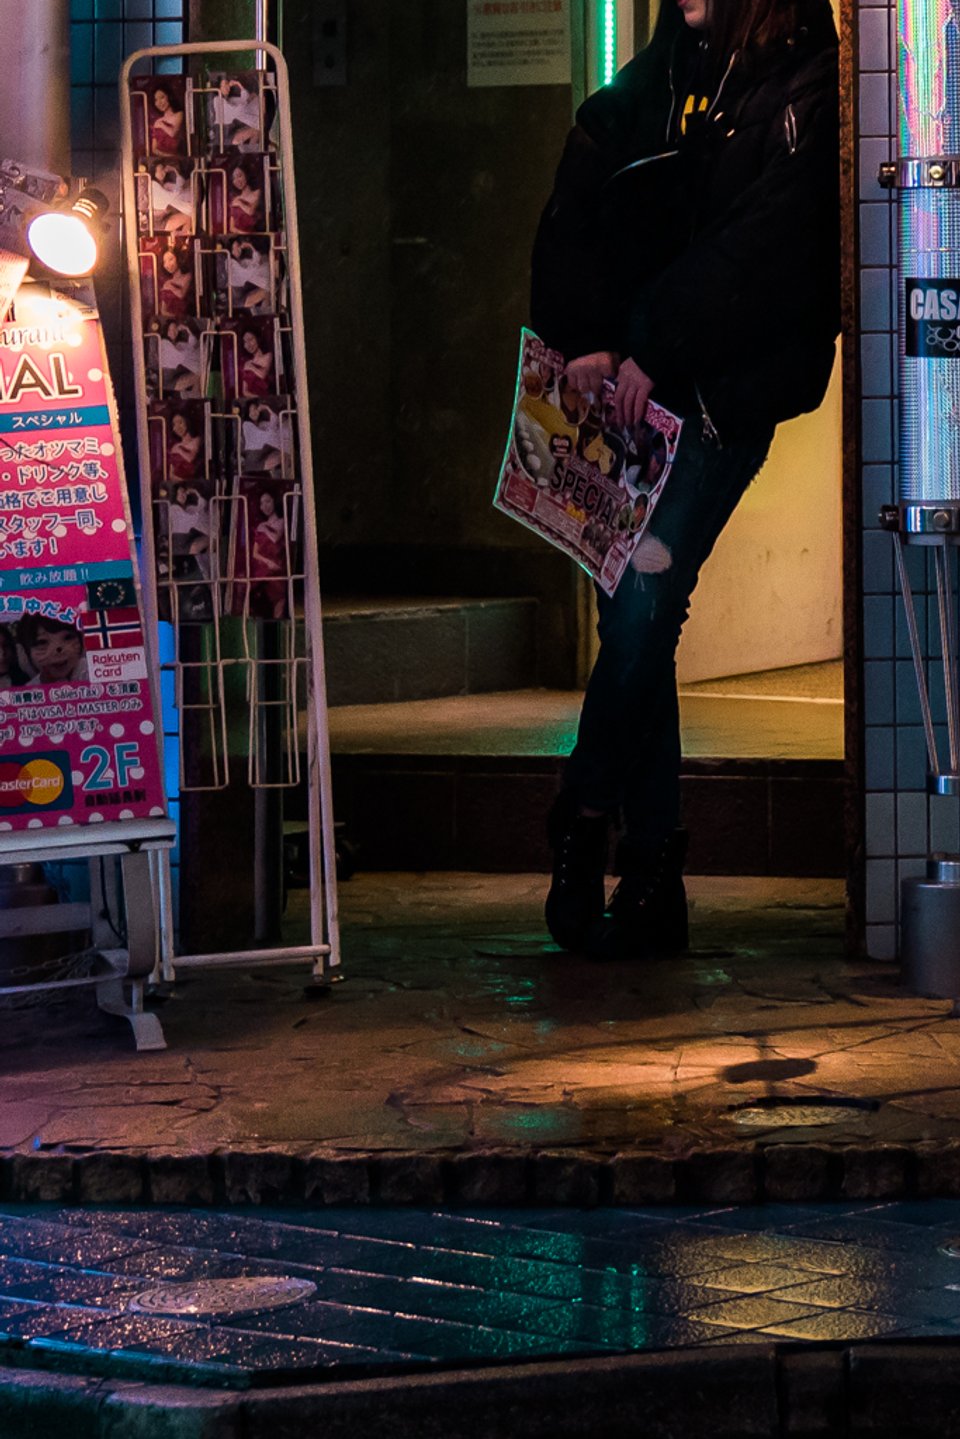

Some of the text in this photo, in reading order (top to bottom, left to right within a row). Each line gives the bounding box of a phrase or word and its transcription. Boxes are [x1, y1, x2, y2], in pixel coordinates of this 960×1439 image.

[12, 412, 83, 429] スペシャル
[92, 652, 140, 665] Rakuten
[94, 667, 122, 678] Card
[80, 742, 140, 791] 2F
[0, 776, 60, 792] asterCard
